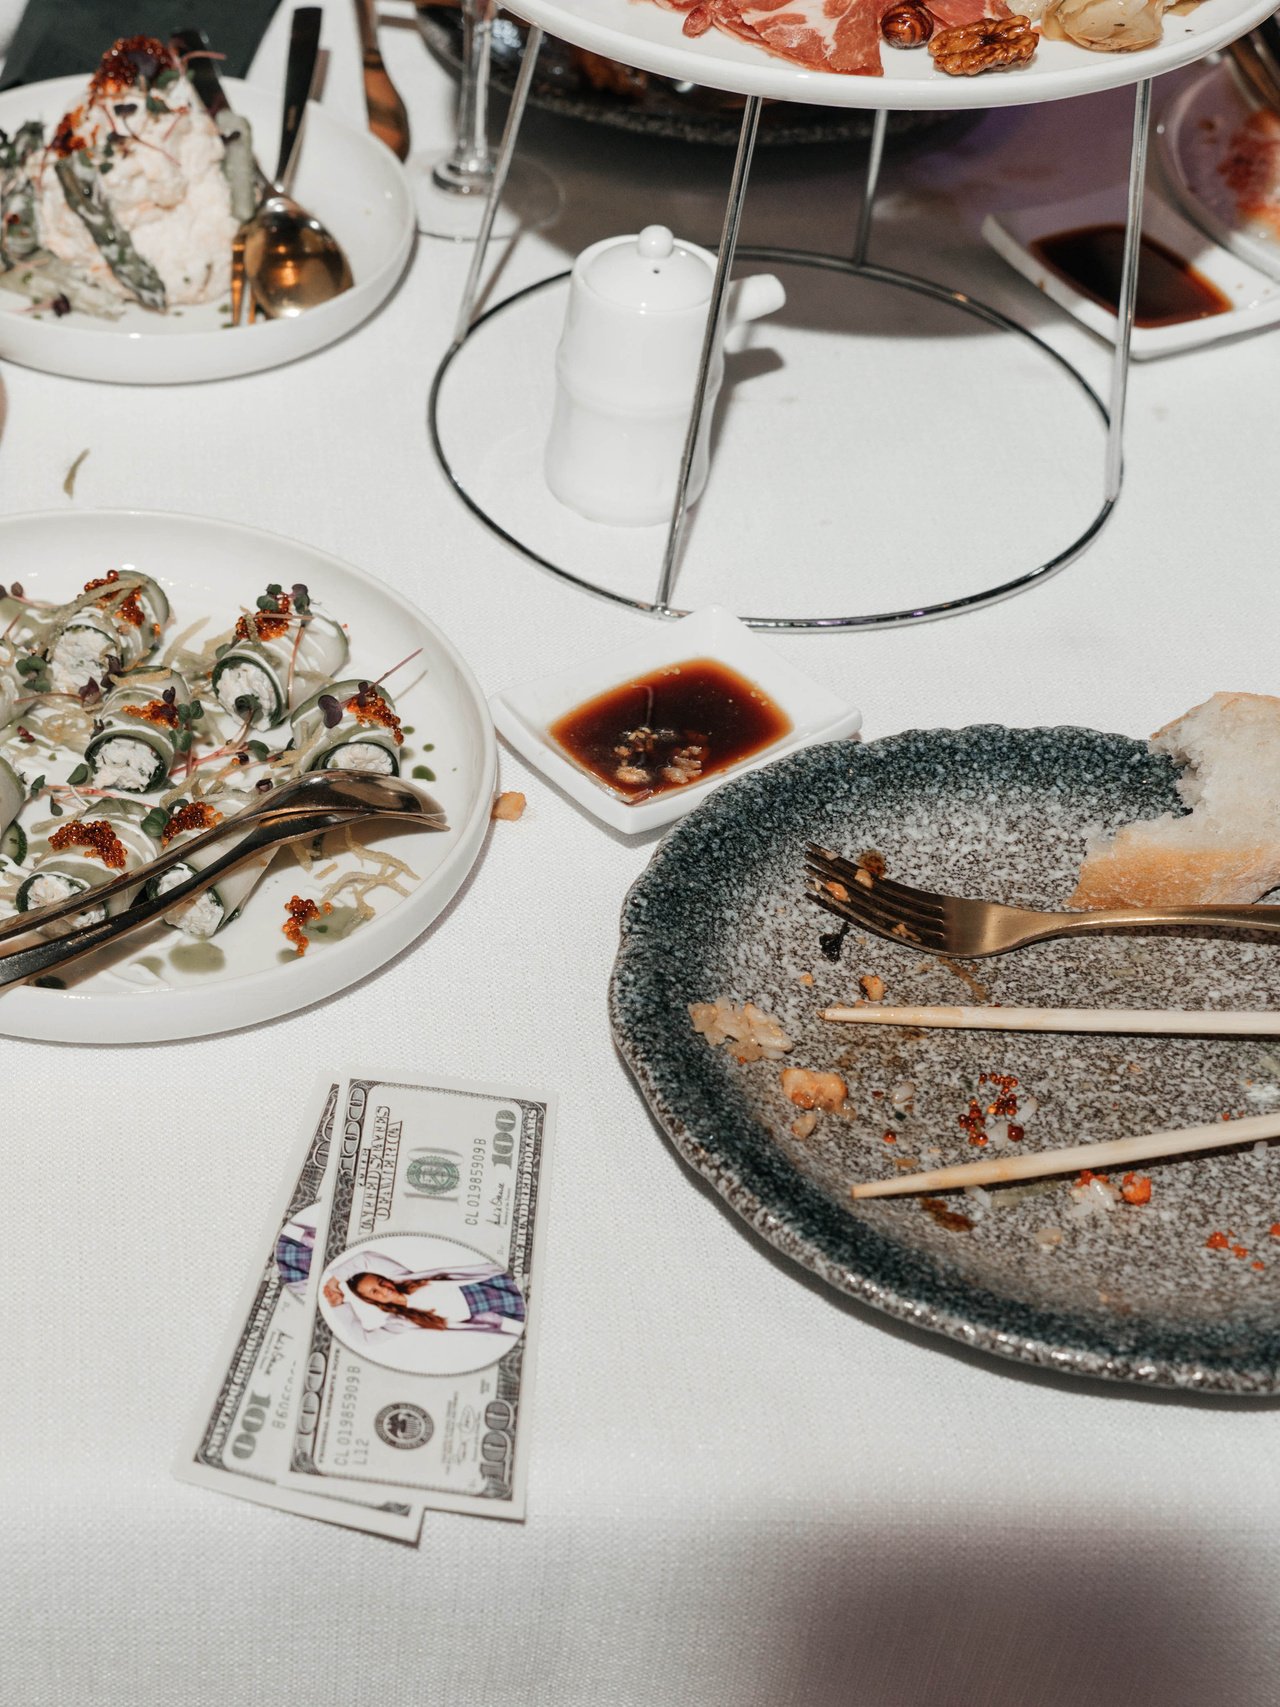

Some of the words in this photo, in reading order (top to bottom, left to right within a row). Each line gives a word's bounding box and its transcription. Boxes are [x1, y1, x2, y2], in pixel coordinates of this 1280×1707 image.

[337, 1087, 367, 1175] 100
[366, 1104, 391, 1169] STATES
[489, 1108, 517, 1169] 100
[521, 1106, 538, 1172] DOLLARS
[357, 1169, 382, 1236] UNITED
[514, 1171, 532, 1247] HUNDRED
[512, 1246, 526, 1276] ONE
[232, 1390, 273, 1460] 100
[351, 1437, 370, 1465] L12
[479, 1399, 513, 1482] 100
